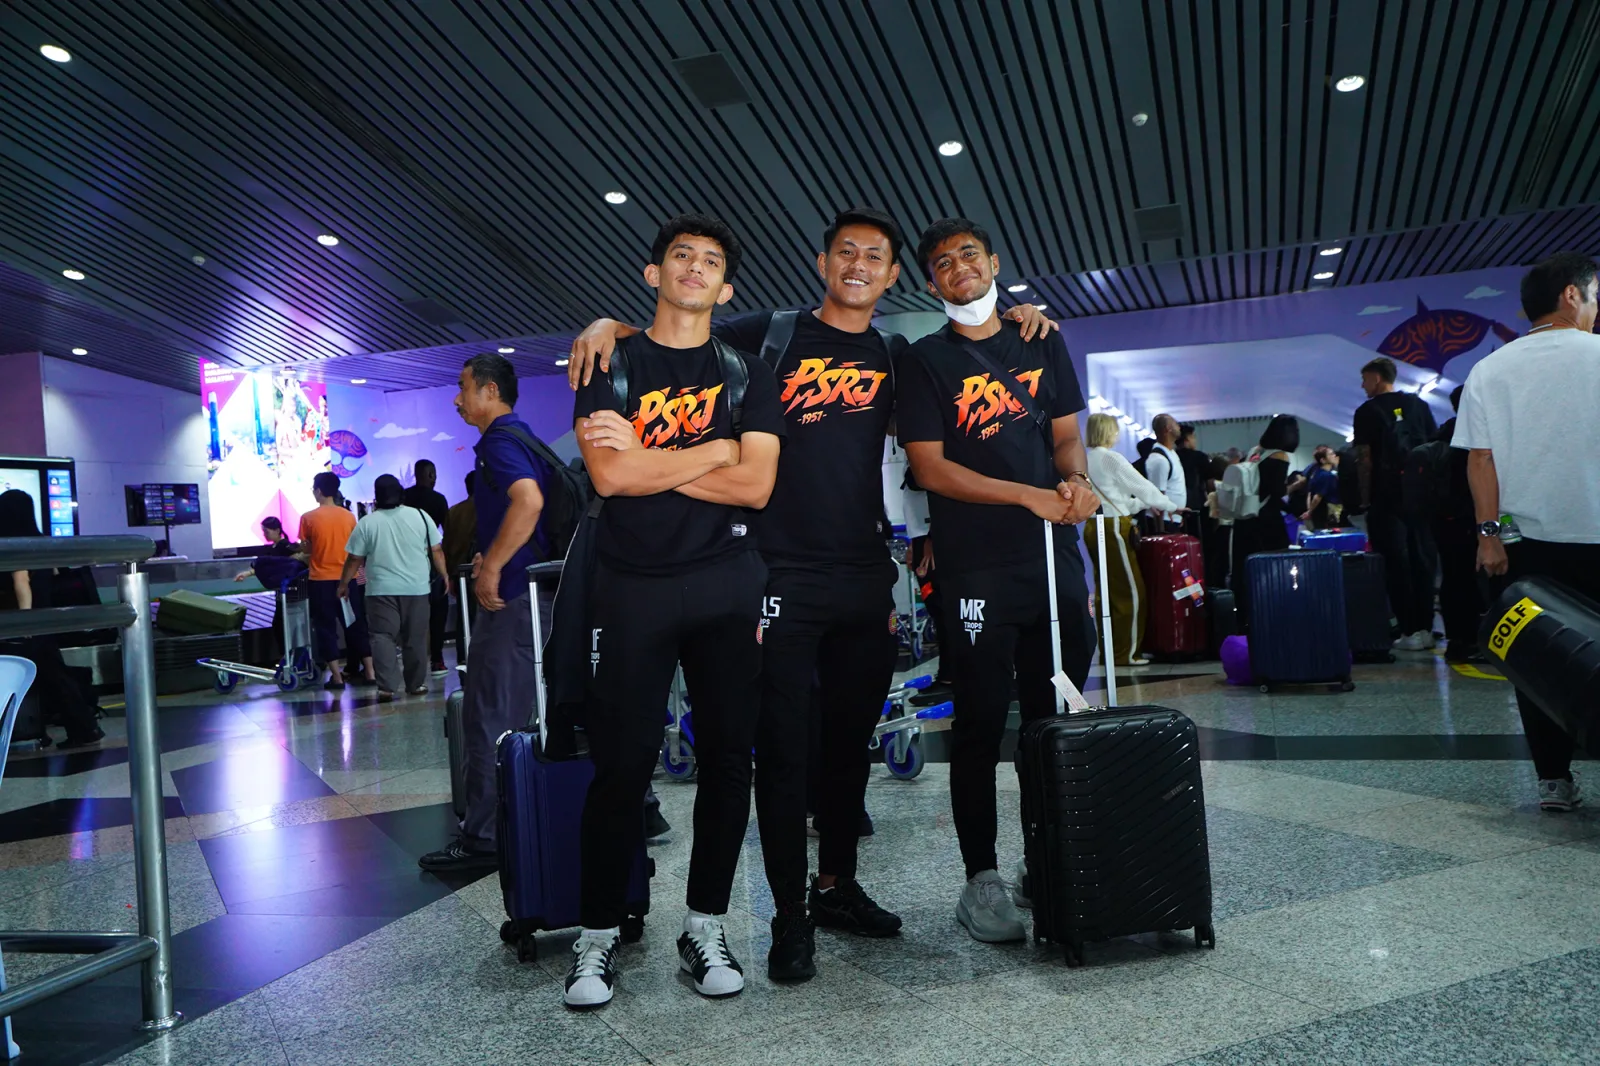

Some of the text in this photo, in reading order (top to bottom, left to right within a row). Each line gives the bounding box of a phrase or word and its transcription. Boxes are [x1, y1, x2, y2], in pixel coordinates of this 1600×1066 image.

[780, 357, 888, 416] PSRJ
[631, 382, 724, 449] PSRJ
[960, 598, 986, 621] MR
[1491, 604, 1528, 649] GOLF
